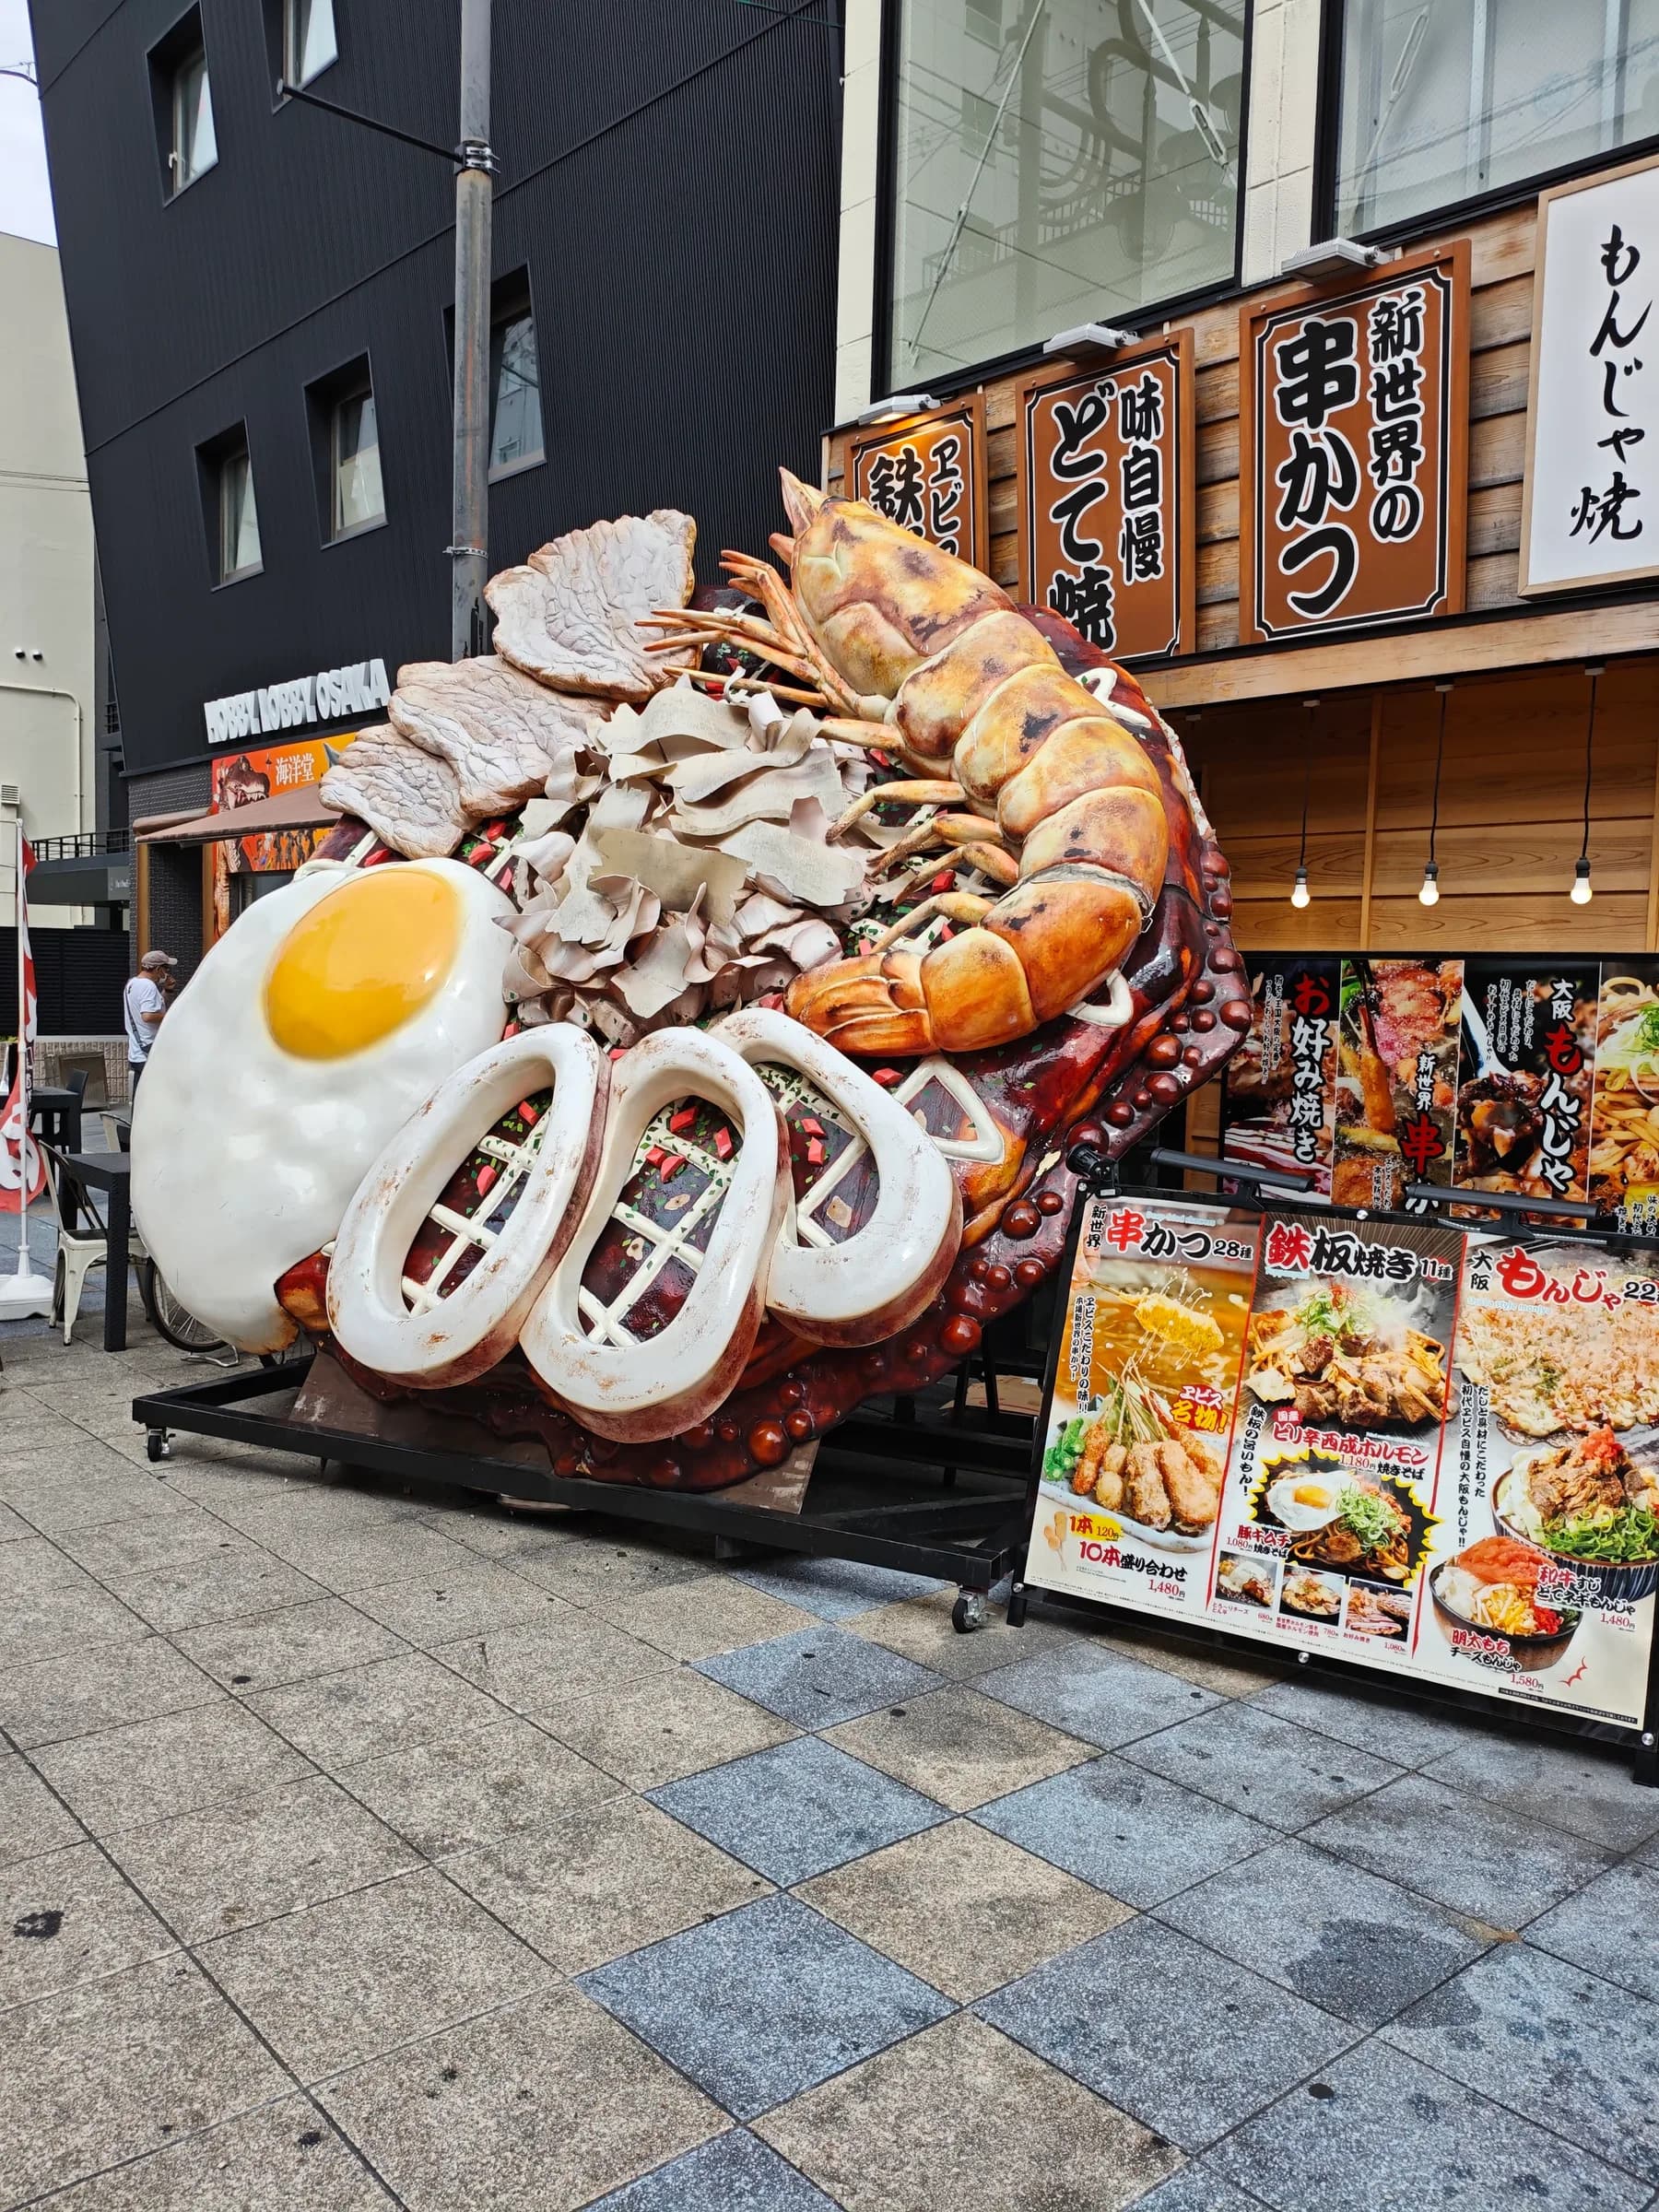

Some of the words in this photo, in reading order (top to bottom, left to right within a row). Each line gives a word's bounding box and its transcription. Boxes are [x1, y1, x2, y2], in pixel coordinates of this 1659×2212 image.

[1570, 224, 1653, 545] もんじゃ焼
[1370, 289, 1423, 541] 新世界の
[1119, 372, 1162, 583] 味自慢
[1276, 319, 1359, 618] 串かつ
[869, 446, 924, 536] 鉄
[1050, 380, 1115, 650] どて焼
[258, 677, 317, 732] LOBBY
[316, 658, 391, 720] OSAKA
[276, 752, 314, 785] 海洋堂
[1290, 973, 1330, 1162] お好み焼き
[1541, 1023, 1581, 1192] もんじゃ
[1087, 1205, 1107, 1248] 新世界
[1107, 1209, 1211, 1259] 串かつ
[1267, 1223, 1416, 1279] 鉄板焼き
[1470, 1250, 1493, 1291] 大阪
[1496, 1246, 1622, 1311] もんじゃ
[1171, 1399, 1228, 1434] 名物!
[1273, 1424, 1430, 1465] ピリ辛西成ホルモン
[1377, 1462, 1426, 1481] 焼きそば
[1070, 1514, 1092, 1534] 1本
[1238, 1524, 1290, 1547] 豚キムチ
[1079, 1541, 1188, 1583] 10本盛り合わせ
[1538, 1566, 1601, 1593] 和牛すじ
[1148, 1579, 1185, 1598] 1,480円
[1536, 1585, 1636, 1616] どてネギもんじゃ
[1453, 1629, 1510, 1655] 明太もち
[1600, 1613, 1635, 1630] 1,480円
[1451, 1647, 1522, 1673] チーズもんじゃ
[1511, 1673, 1544, 1690] 1,580円
